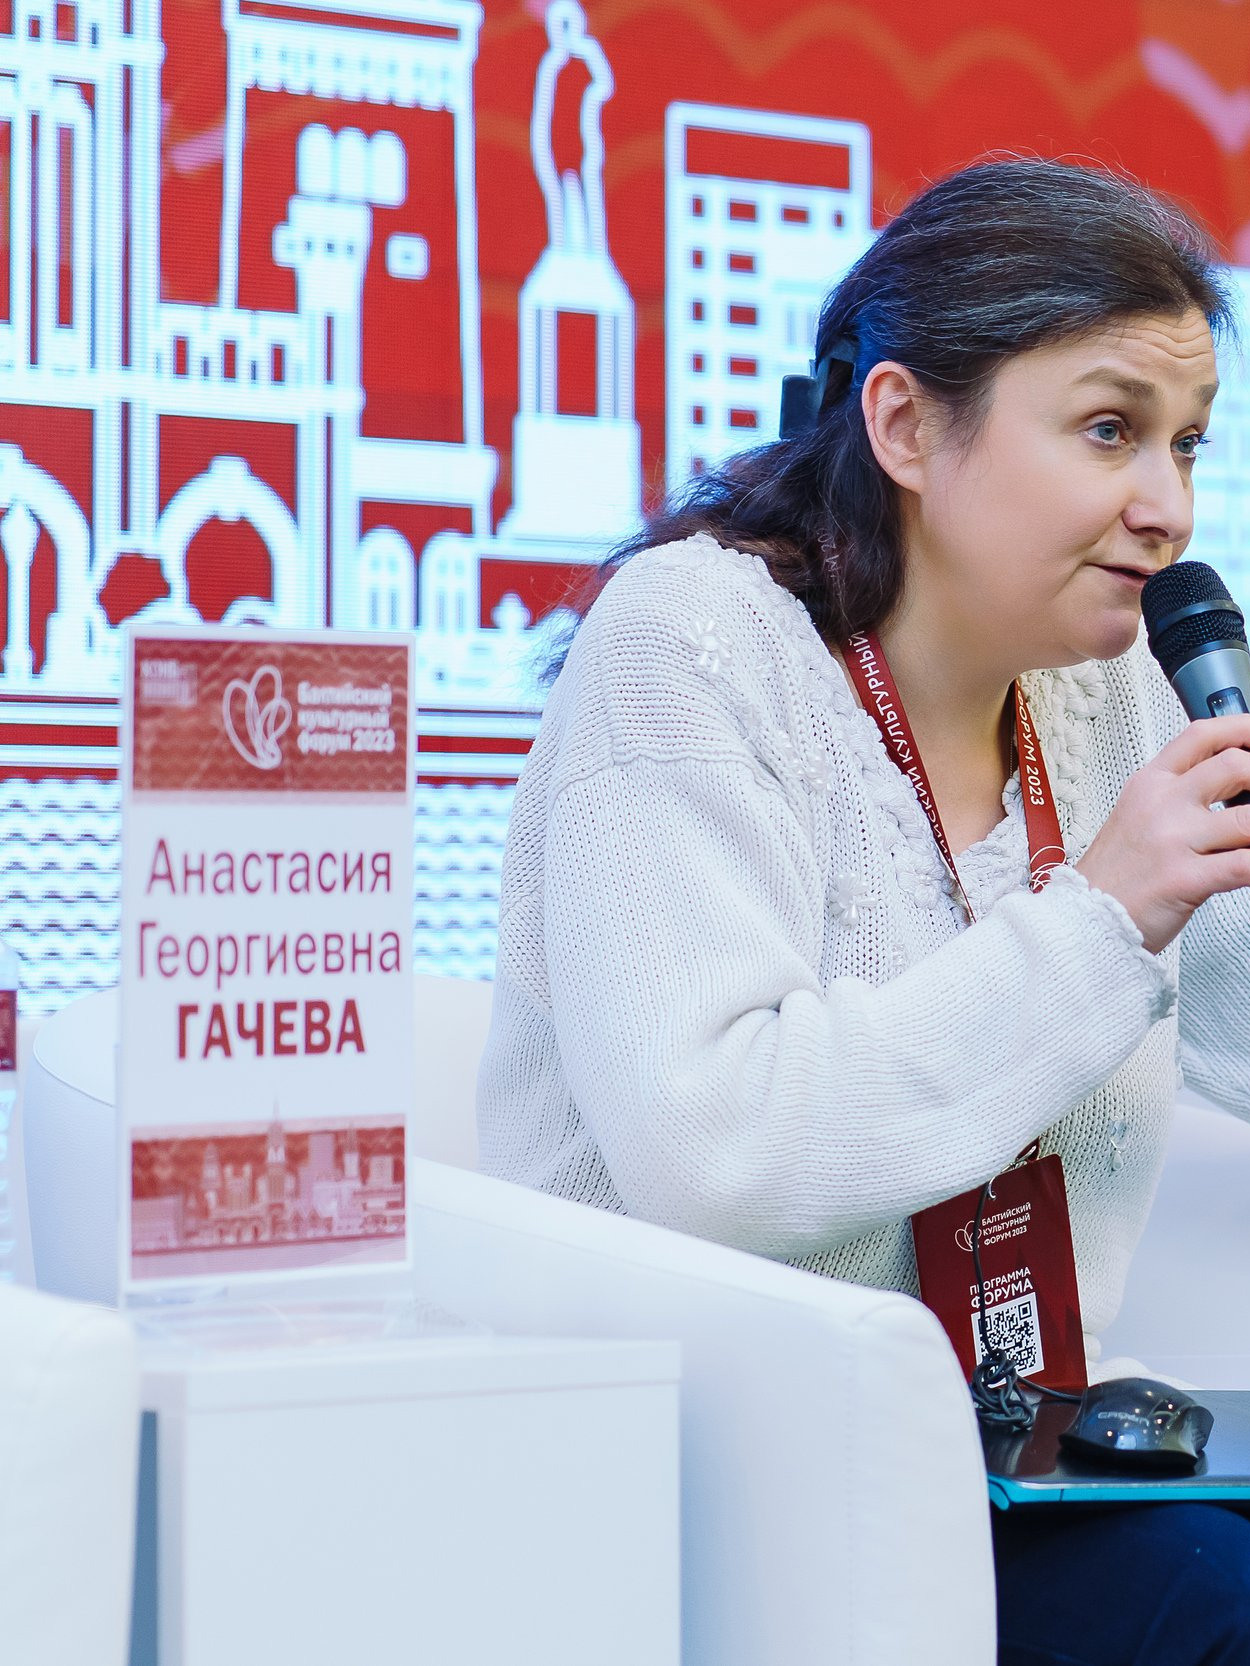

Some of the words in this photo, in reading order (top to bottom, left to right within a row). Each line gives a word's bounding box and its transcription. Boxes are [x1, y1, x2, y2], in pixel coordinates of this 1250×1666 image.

[848, 630, 914, 764] КУЛЬТУРНЫЙ
[352, 728, 396, 753] 2023
[1026, 764, 1045, 806] 2023
[145, 837, 393, 895] Анастасия
[137, 921, 402, 990] Георгиевна
[176, 999, 366, 1060] ГАЧЕВА
[981, 1202, 1032, 1227] БАЛТИЙСКИЙ
[982, 1212, 1031, 1237] КУЛЬТУРНЫЙ
[984, 1230, 1012, 1246] ФОРУМ
[1011, 1225, 1028, 1237] 2023
